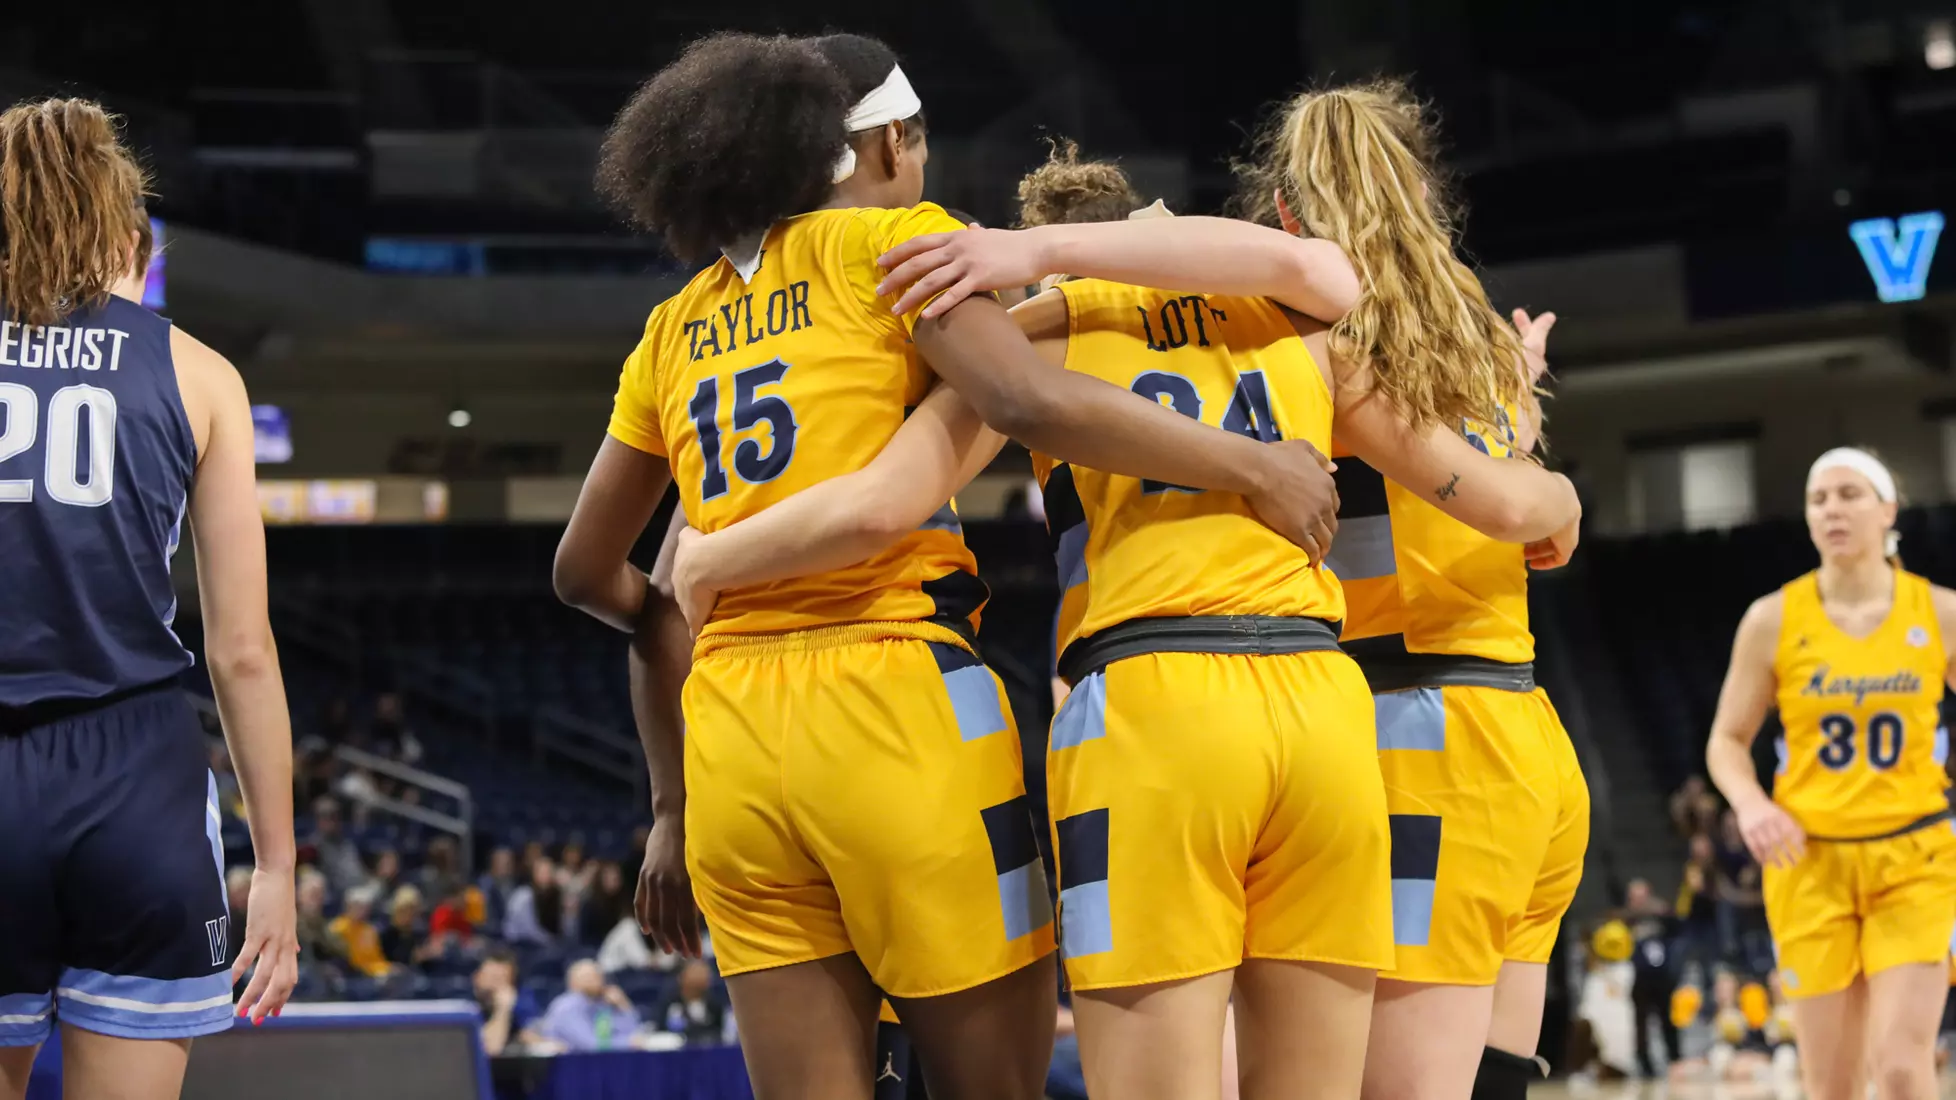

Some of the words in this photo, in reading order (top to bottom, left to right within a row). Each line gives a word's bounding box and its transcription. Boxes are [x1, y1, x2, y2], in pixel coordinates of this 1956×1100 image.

[1849, 210, 1945, 303] V
[0, 321, 129, 371] EGRIST
[683, 280, 812, 364] TAYLOR
[0, 381, 117, 507] 20
[688, 355, 800, 503] 15
[1801, 663, 1921, 706] Marquette
[1818, 712, 1904, 770] 30
[205, 914, 227, 967] V
